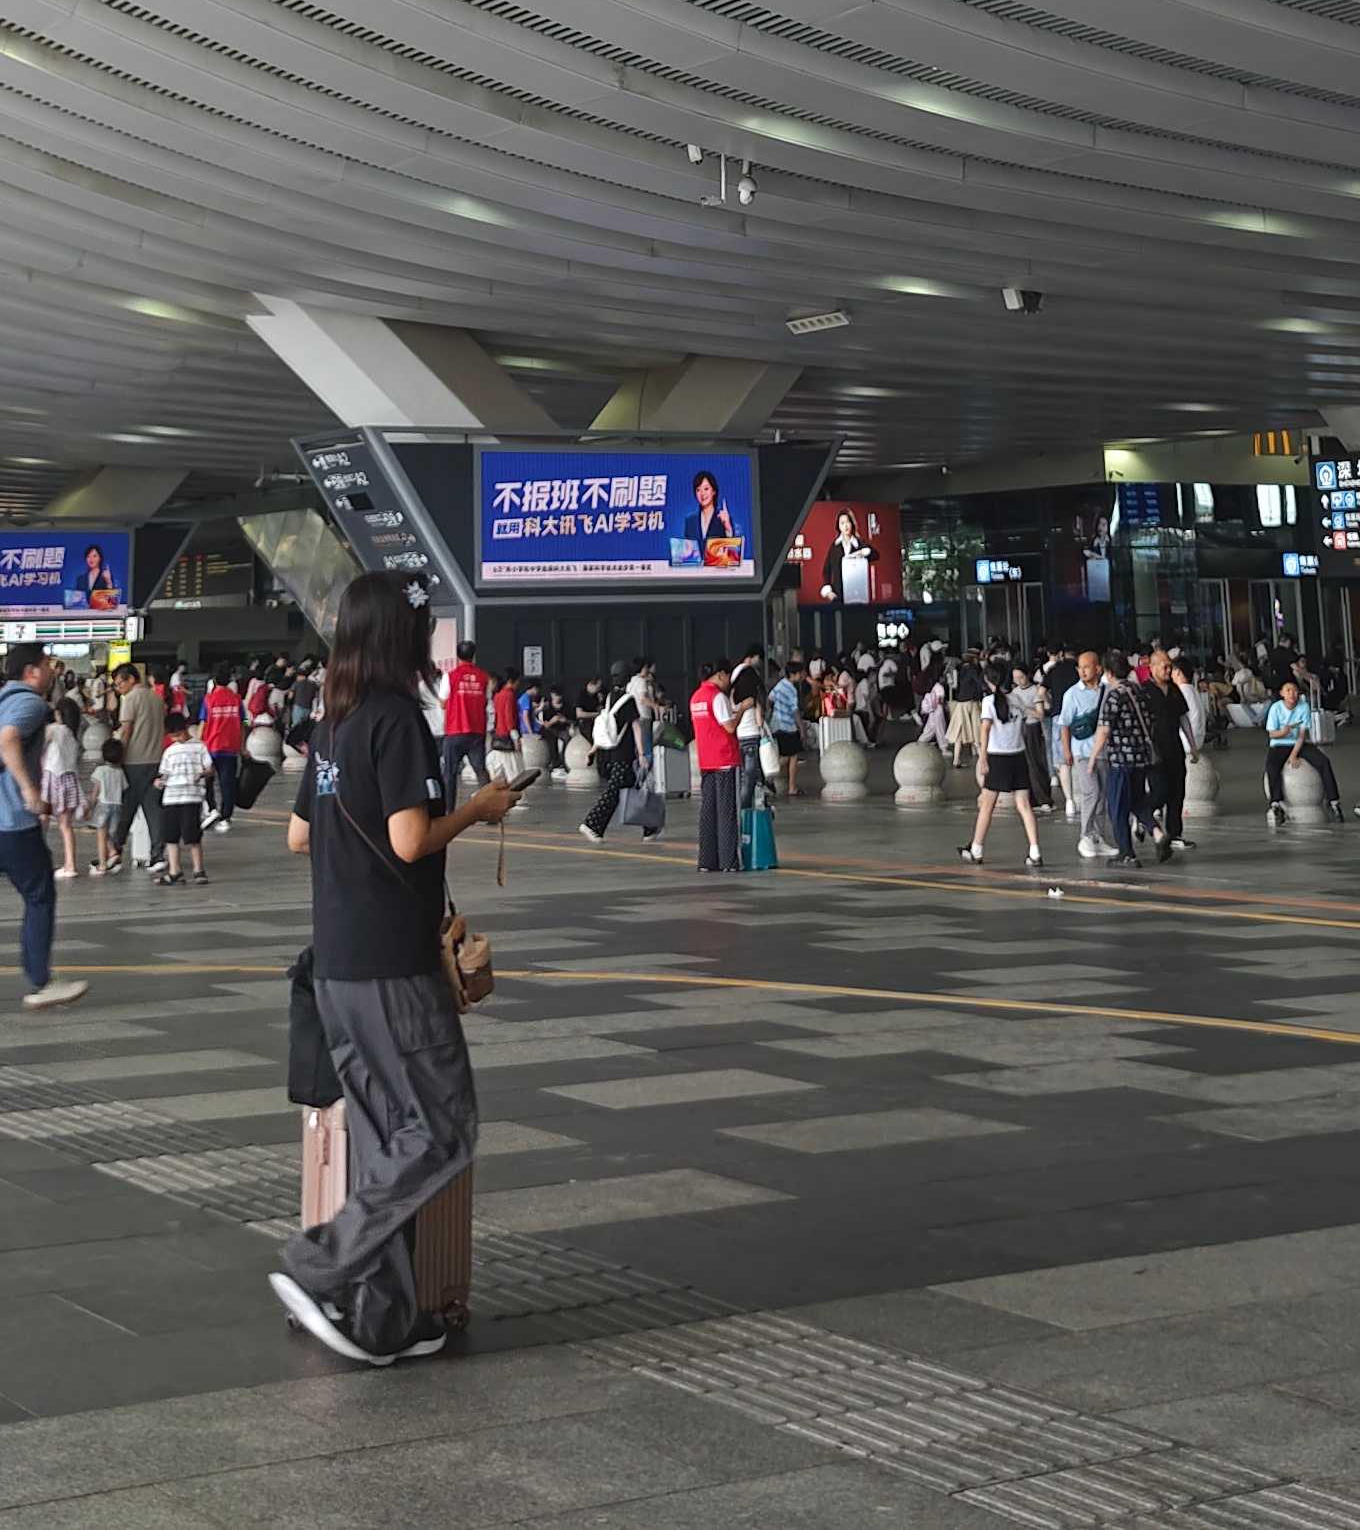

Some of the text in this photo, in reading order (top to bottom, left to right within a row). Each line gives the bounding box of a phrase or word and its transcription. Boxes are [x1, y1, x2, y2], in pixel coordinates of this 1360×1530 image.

[492, 475, 668, 513] 不报班不刷题
